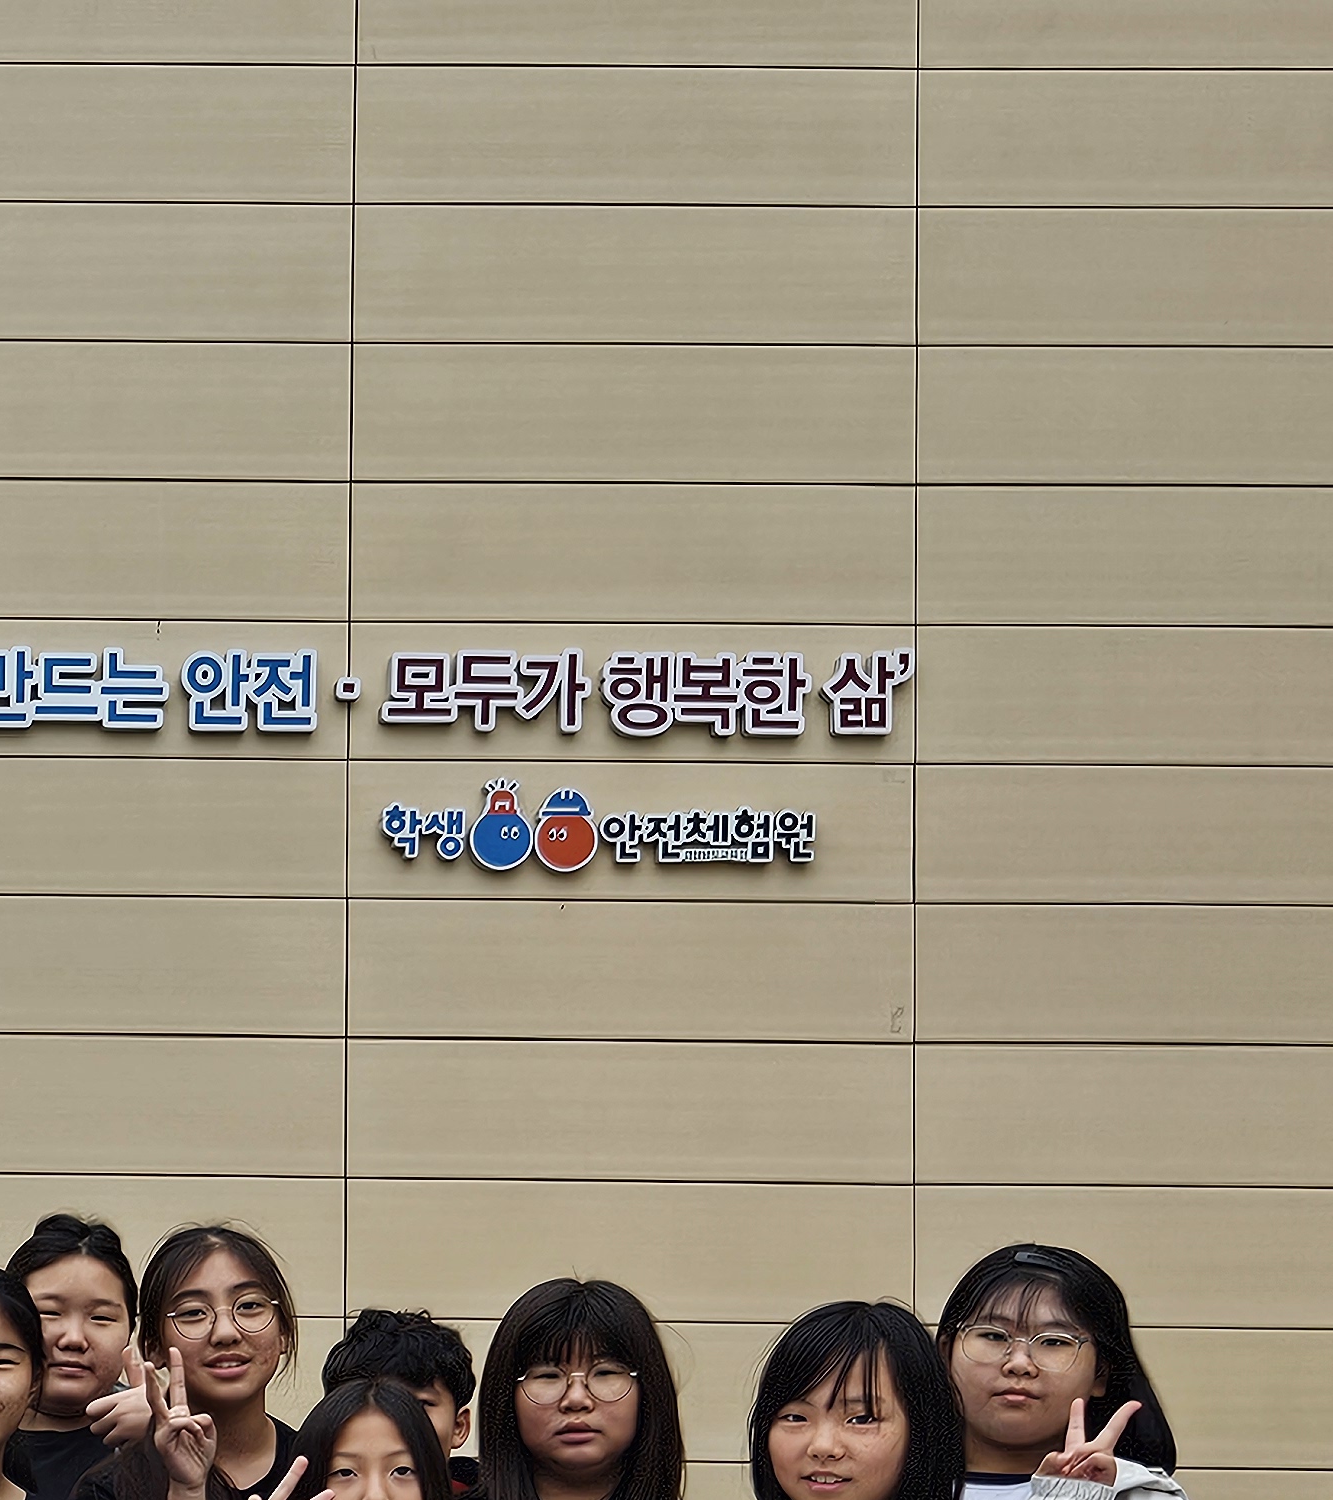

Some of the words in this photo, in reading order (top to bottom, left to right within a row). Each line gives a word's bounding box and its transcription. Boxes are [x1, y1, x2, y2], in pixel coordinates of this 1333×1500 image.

[183, 650, 318, 731] 안전
[380, 649, 590, 733] 모두가
[603, 651, 811, 736] 행복한
[382, 801, 465, 860] 학생
[600, 806, 815, 863] 안전체험원
